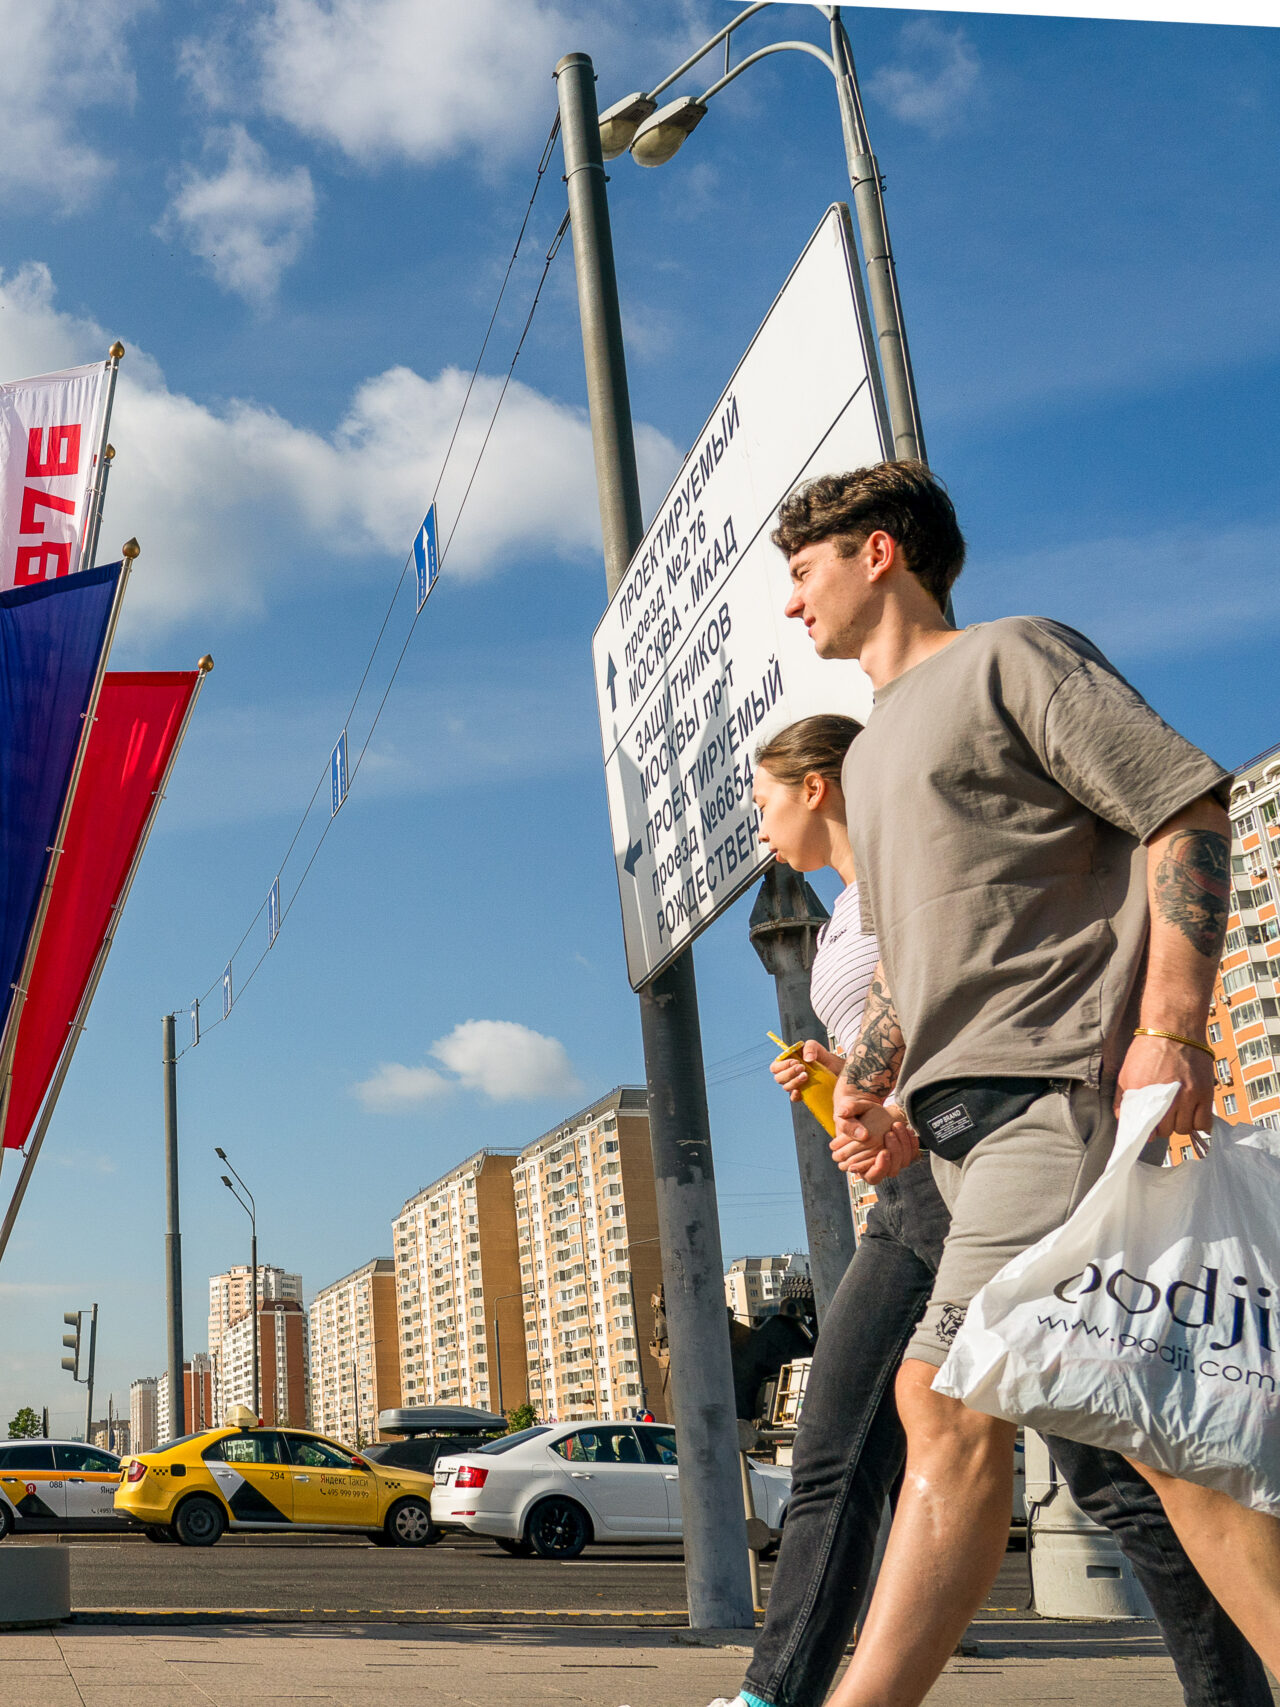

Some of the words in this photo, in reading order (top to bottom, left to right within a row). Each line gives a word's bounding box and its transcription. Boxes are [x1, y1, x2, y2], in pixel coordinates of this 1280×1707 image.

[619, 391, 740, 629] ПРОЕКТИРУЕМЫЙ
[625, 584, 666, 667] проезд
[666, 510, 706, 594] №276
[628, 606, 682, 707] МОСКВА
[690, 515, 738, 608] МКАД
[635, 602, 731, 762] ЗАЩИТНИКОВ
[640, 698, 700, 803] МОСКВЫ
[703, 659, 734, 718] пр-т
[646, 653, 783, 854] ПРОЕКТИРУЕМЫЙ
[652, 825, 700, 896] проезд
[700, 753, 754, 841] №6654
[656, 808, 764, 944] РОЖДЕСТВЕН
[1053, 1262, 1276, 1352] oodji
[269, 1472, 285, 1480] 294
[320, 1473, 346, 1486] Яндекс
[349, 1475, 369, 1487] Такси
